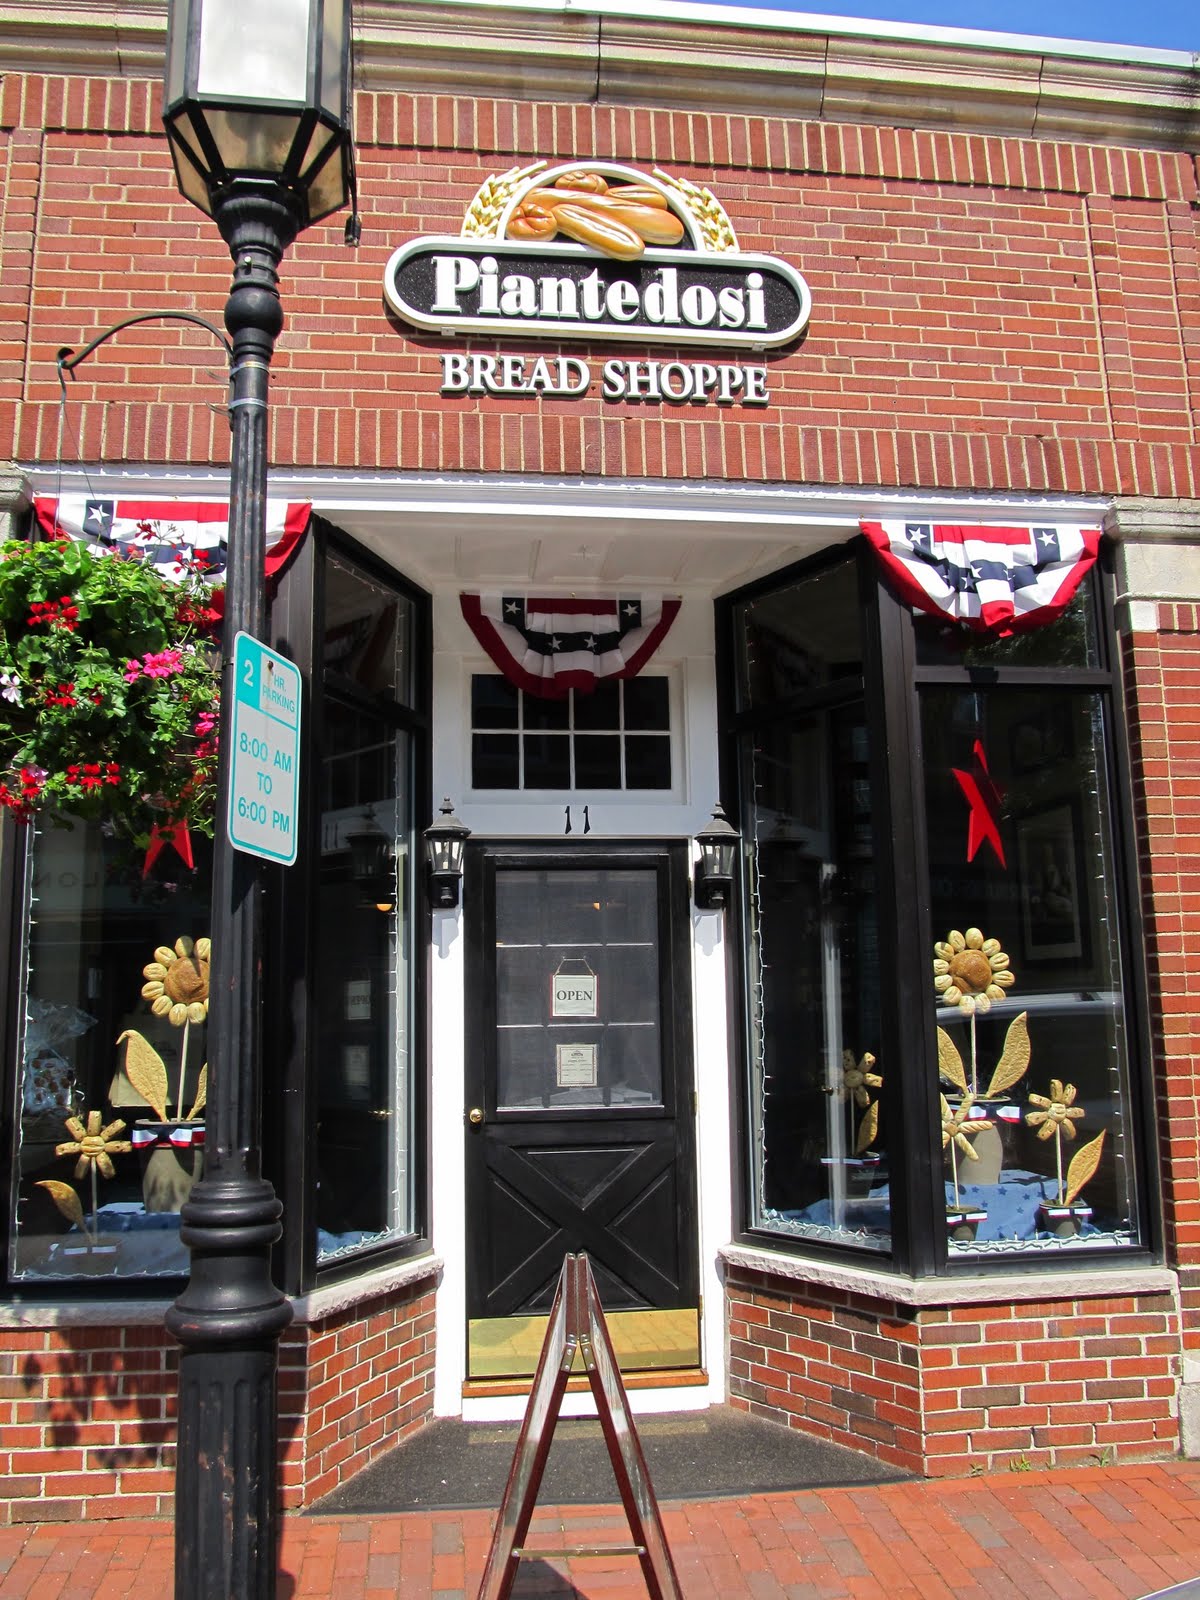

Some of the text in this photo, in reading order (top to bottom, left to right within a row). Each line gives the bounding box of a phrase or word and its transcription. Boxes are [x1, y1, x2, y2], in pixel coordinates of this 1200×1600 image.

[431, 255, 768, 329] Piantedosi
[440, 353, 770, 408] BREAD SHOPPE
[243, 658, 254, 687] 2
[262, 684, 295, 713] PARKING
[239, 732, 292, 773] 8:00 AM
[257, 771, 273, 795] TO
[238, 797, 290, 833] 6:00 PM
[564, 805, 591, 835] 11
[556, 990, 593, 1001] OPEN
